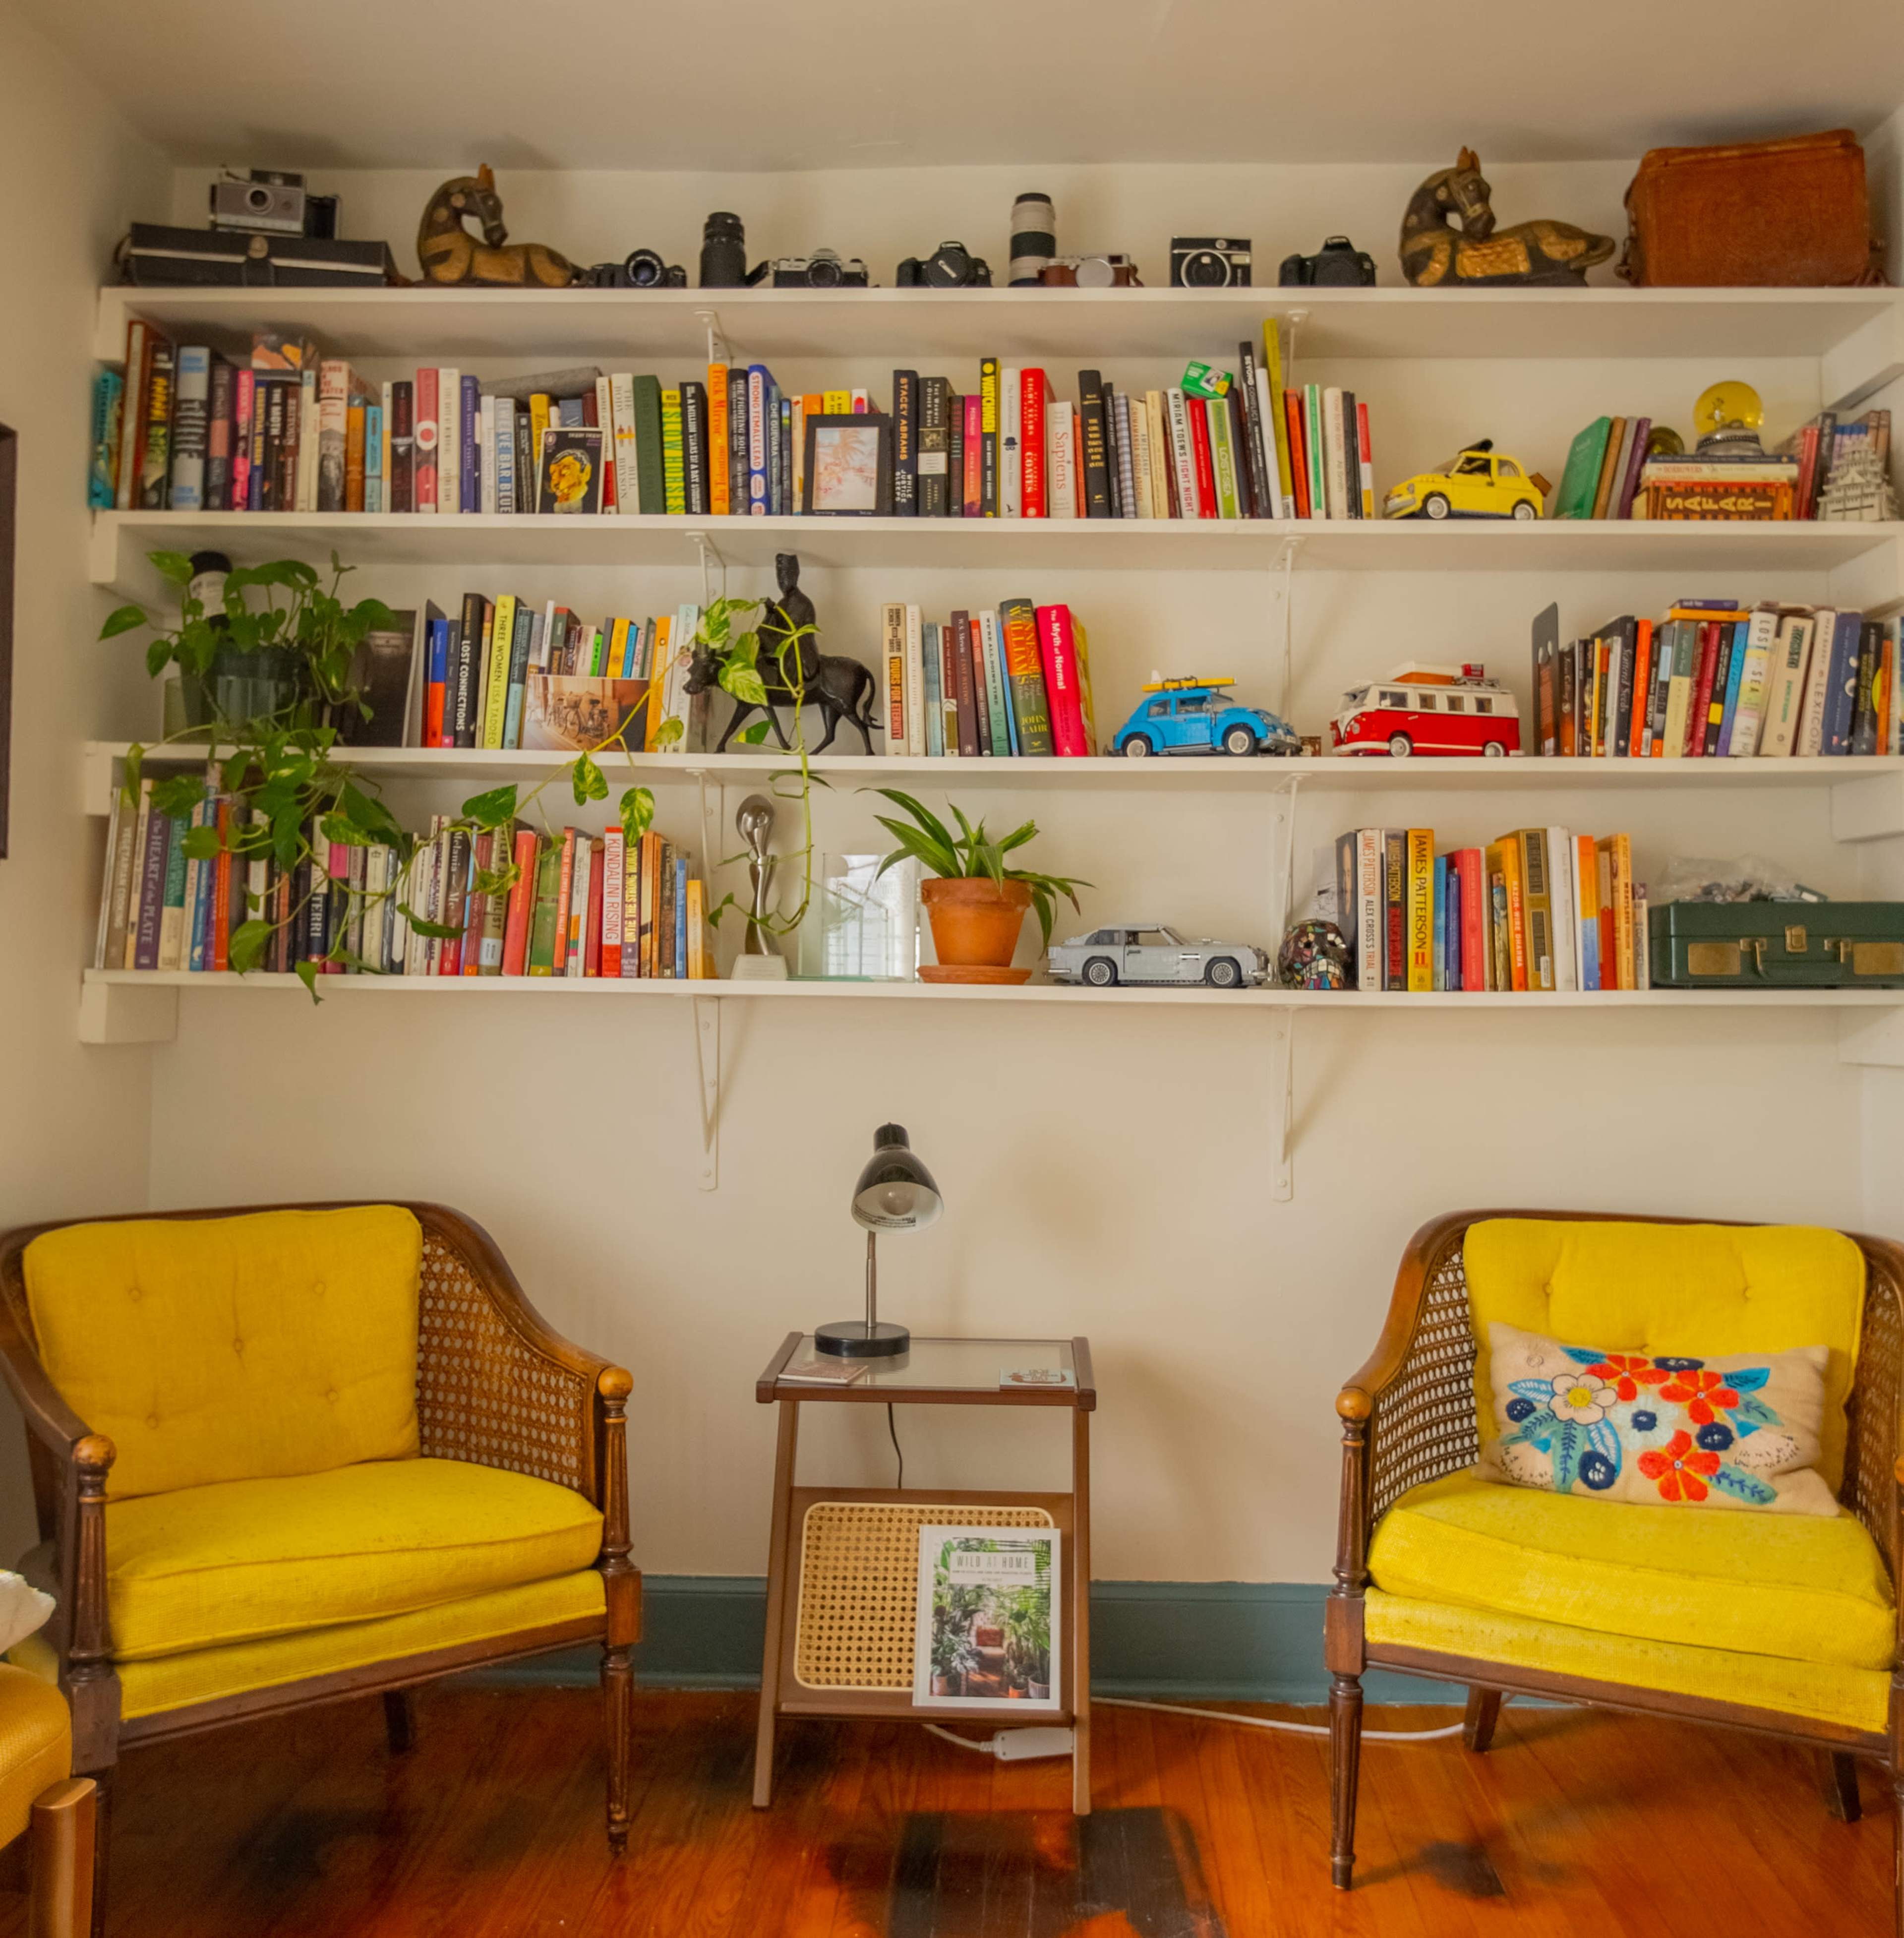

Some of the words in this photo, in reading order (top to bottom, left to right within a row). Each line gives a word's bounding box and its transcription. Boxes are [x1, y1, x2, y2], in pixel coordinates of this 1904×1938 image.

[712, 368, 727, 395] Trick
[1244, 355, 1254, 386] BEYOND
[614, 386, 623, 413] BODY
[624, 389, 632, 411] THE
[751, 375, 760, 408] STRONG
[899, 377, 908, 416] STACEY
[982, 374, 996, 433] WATCHMEN
[1248, 386, 1257, 422] CONFLICT
[687, 405, 697, 433] MILLION
[713, 399, 727, 436] Mirror
[1172, 393, 1183, 425] MIRIAM
[662, 411, 682, 450] SLOW
[752, 411, 760, 445] FEMALE
[898, 419, 908, 461] ABRAMS
[1175, 427, 1187, 457] TOEWS
[688, 434, 698, 454] YEARS
[690, 455, 698, 463] IN
[737, 435, 746, 456] SOUL
[753, 446, 761, 467] LEAD
[498, 453, 513, 478] BAR
[1024, 451, 1034, 493] COATES
[1051, 431, 1070, 490] Sapiens
[1180, 459, 1190, 484] FIGHT
[618, 457, 628, 500] BRYSON
[628, 466, 636, 489] BILL
[664, 456, 685, 513] HORSES
[690, 469, 700, 483] DAY
[1183, 486, 1194, 513] NIGHT
[1666, 496, 1772, 512] SAFARI
[497, 615, 507, 641] THREE
[1049, 623, 1062, 646] Myth
[1756, 619, 1771, 650] LOST
[460, 640, 471, 664] LOST
[1009, 605, 1030, 685] WILLIAMS
[1022, 606, 1041, 681] TENNESSEE
[493, 645, 505, 682] WOMEN
[890, 658, 901, 685] YOURS
[1055, 656, 1066, 690] Normal
[491, 685, 501, 704] LISA
[891, 685, 902, 701] FOR
[1749, 670, 1763, 693] SEA
[456, 665, 470, 731] CONNECTIONS
[487, 708, 499, 744] TADDEO
[891, 702, 903, 739] ETERNITY
[1021, 715, 1046, 726] JOHN
[1021, 724, 1048, 734] LAHR
[1809, 682, 1824, 750] LEXICON
[148, 835, 162, 881] HEART
[450, 831, 463, 872] Melania
[626, 847, 638, 873] WOMAN
[1362, 833, 1376, 857] JAMES
[1415, 835, 1427, 874] JAMES
[561, 874, 570, 892] LOWER
[606, 838, 620, 899] KUNDALINI
[1362, 857, 1376, 896] PATTERSON
[1388, 862, 1402, 902] PATTERSON
[448, 892, 460, 909] Me
[491, 867, 508, 929] JONALIST
[625, 874, 638, 903] STRONG
[310, 894, 323, 937] TERRI
[605, 902, 619, 939] RISING
[625, 904, 637, 918] THE
[1365, 900, 1374, 916] ALEX
[1415, 877, 1428, 950] PATTERSON
[1511, 880, 1521, 931] RAZOR-WIRE
[140, 905, 155, 944] PLATE
[558, 915, 567, 934] VALLEY
[624, 919, 637, 942] UNTIE
[1365, 919, 1374, 949] CROSS'S
[1366, 951, 1375, 970] TRIAL
[956, 1556, 980, 1567] WILD
[1002, 1556, 1028, 1568] HOME
